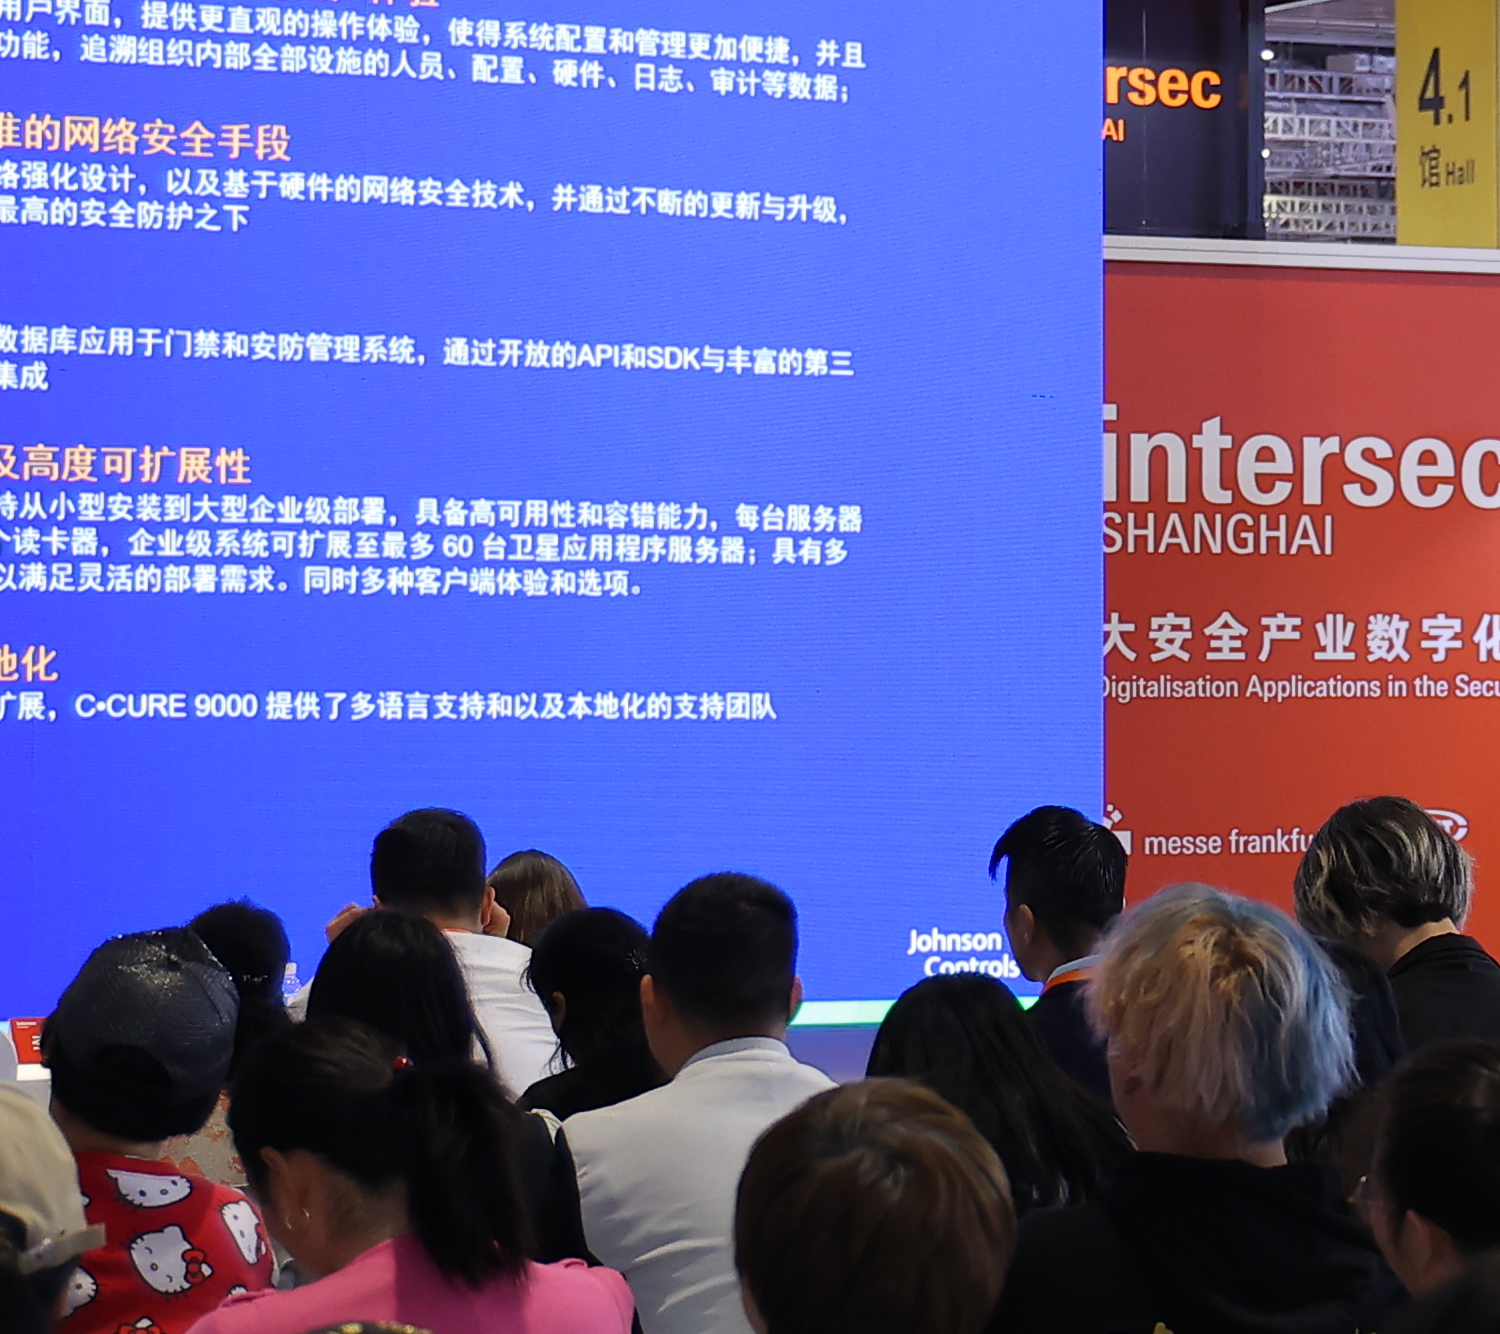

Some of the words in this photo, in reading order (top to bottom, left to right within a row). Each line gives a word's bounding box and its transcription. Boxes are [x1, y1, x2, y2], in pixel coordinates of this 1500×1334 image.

[1418, 47, 1470, 126] 4.1
[1445, 159, 1474, 185] Hall
[442, 533, 474, 559] 60
[1103, 512, 1333, 555] SHANGHAI
[1245, 674, 1381, 703] Applications
[1387, 674, 1408, 697] in
[1414, 675, 1449, 698] the
[194, 693, 258, 719] 9000
[266, 690, 777, 721] 提供了多语言支持和以及本地化的支持团队
[1144, 834, 1222, 855] messe
[1229, 828, 1313, 854] frankfu
[907, 928, 1002, 954] Johnson
[925, 956, 1021, 978] Controls
